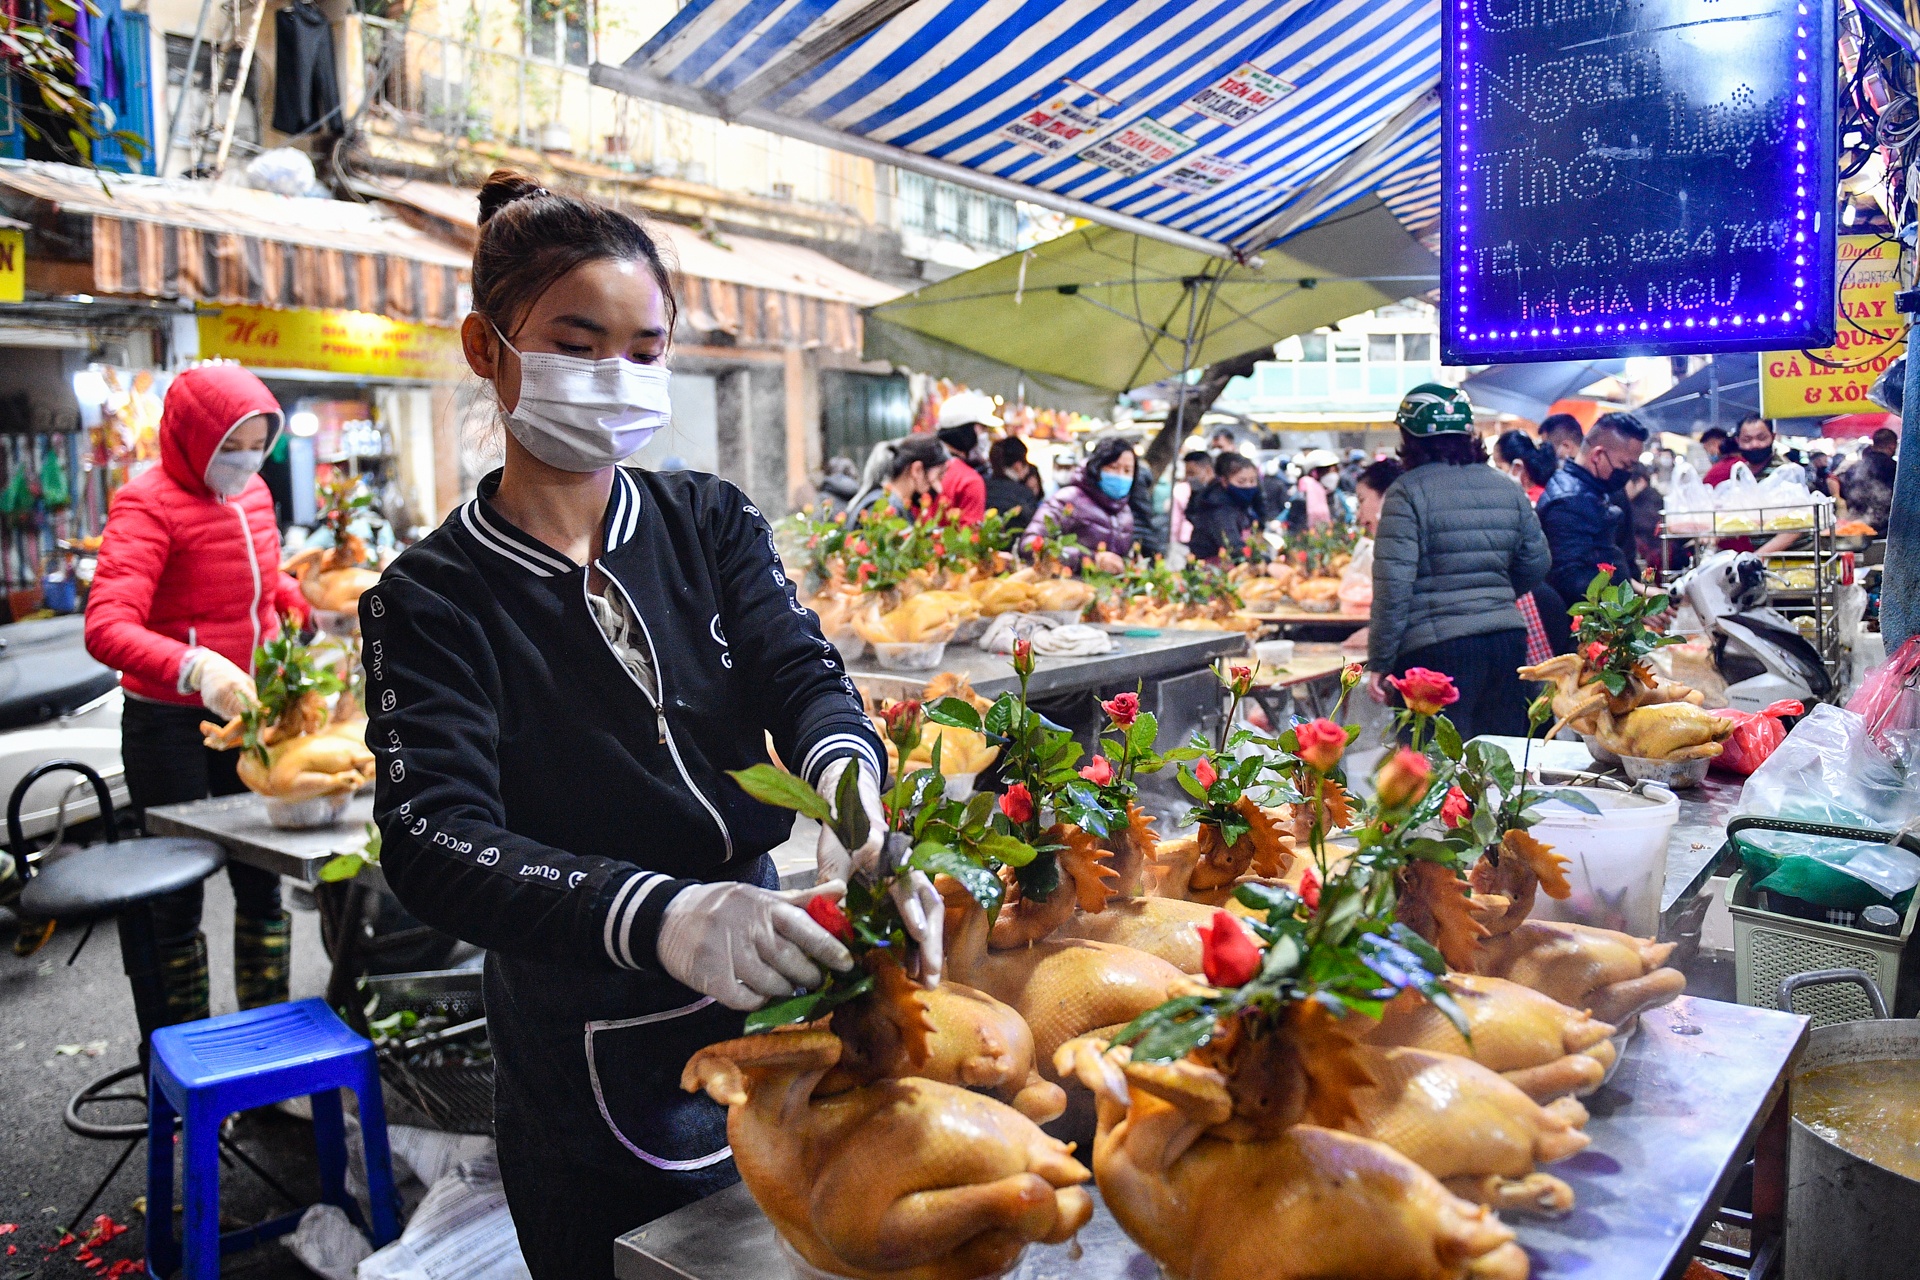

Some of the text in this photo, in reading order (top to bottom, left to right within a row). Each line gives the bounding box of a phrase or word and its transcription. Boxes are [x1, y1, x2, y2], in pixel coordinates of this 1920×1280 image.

[1568, 283, 1634, 316] GIA
[1838, 300, 1887, 319] UAY
[1834, 327, 1900, 350] QUAY
[1769, 355, 1803, 379] GÀ
[1804, 381, 1869, 404] & XÔI
[372, 639, 384, 682] GUCCI
[432, 831, 473, 854] GUCCI
[519, 864, 561, 881] GUCCI
